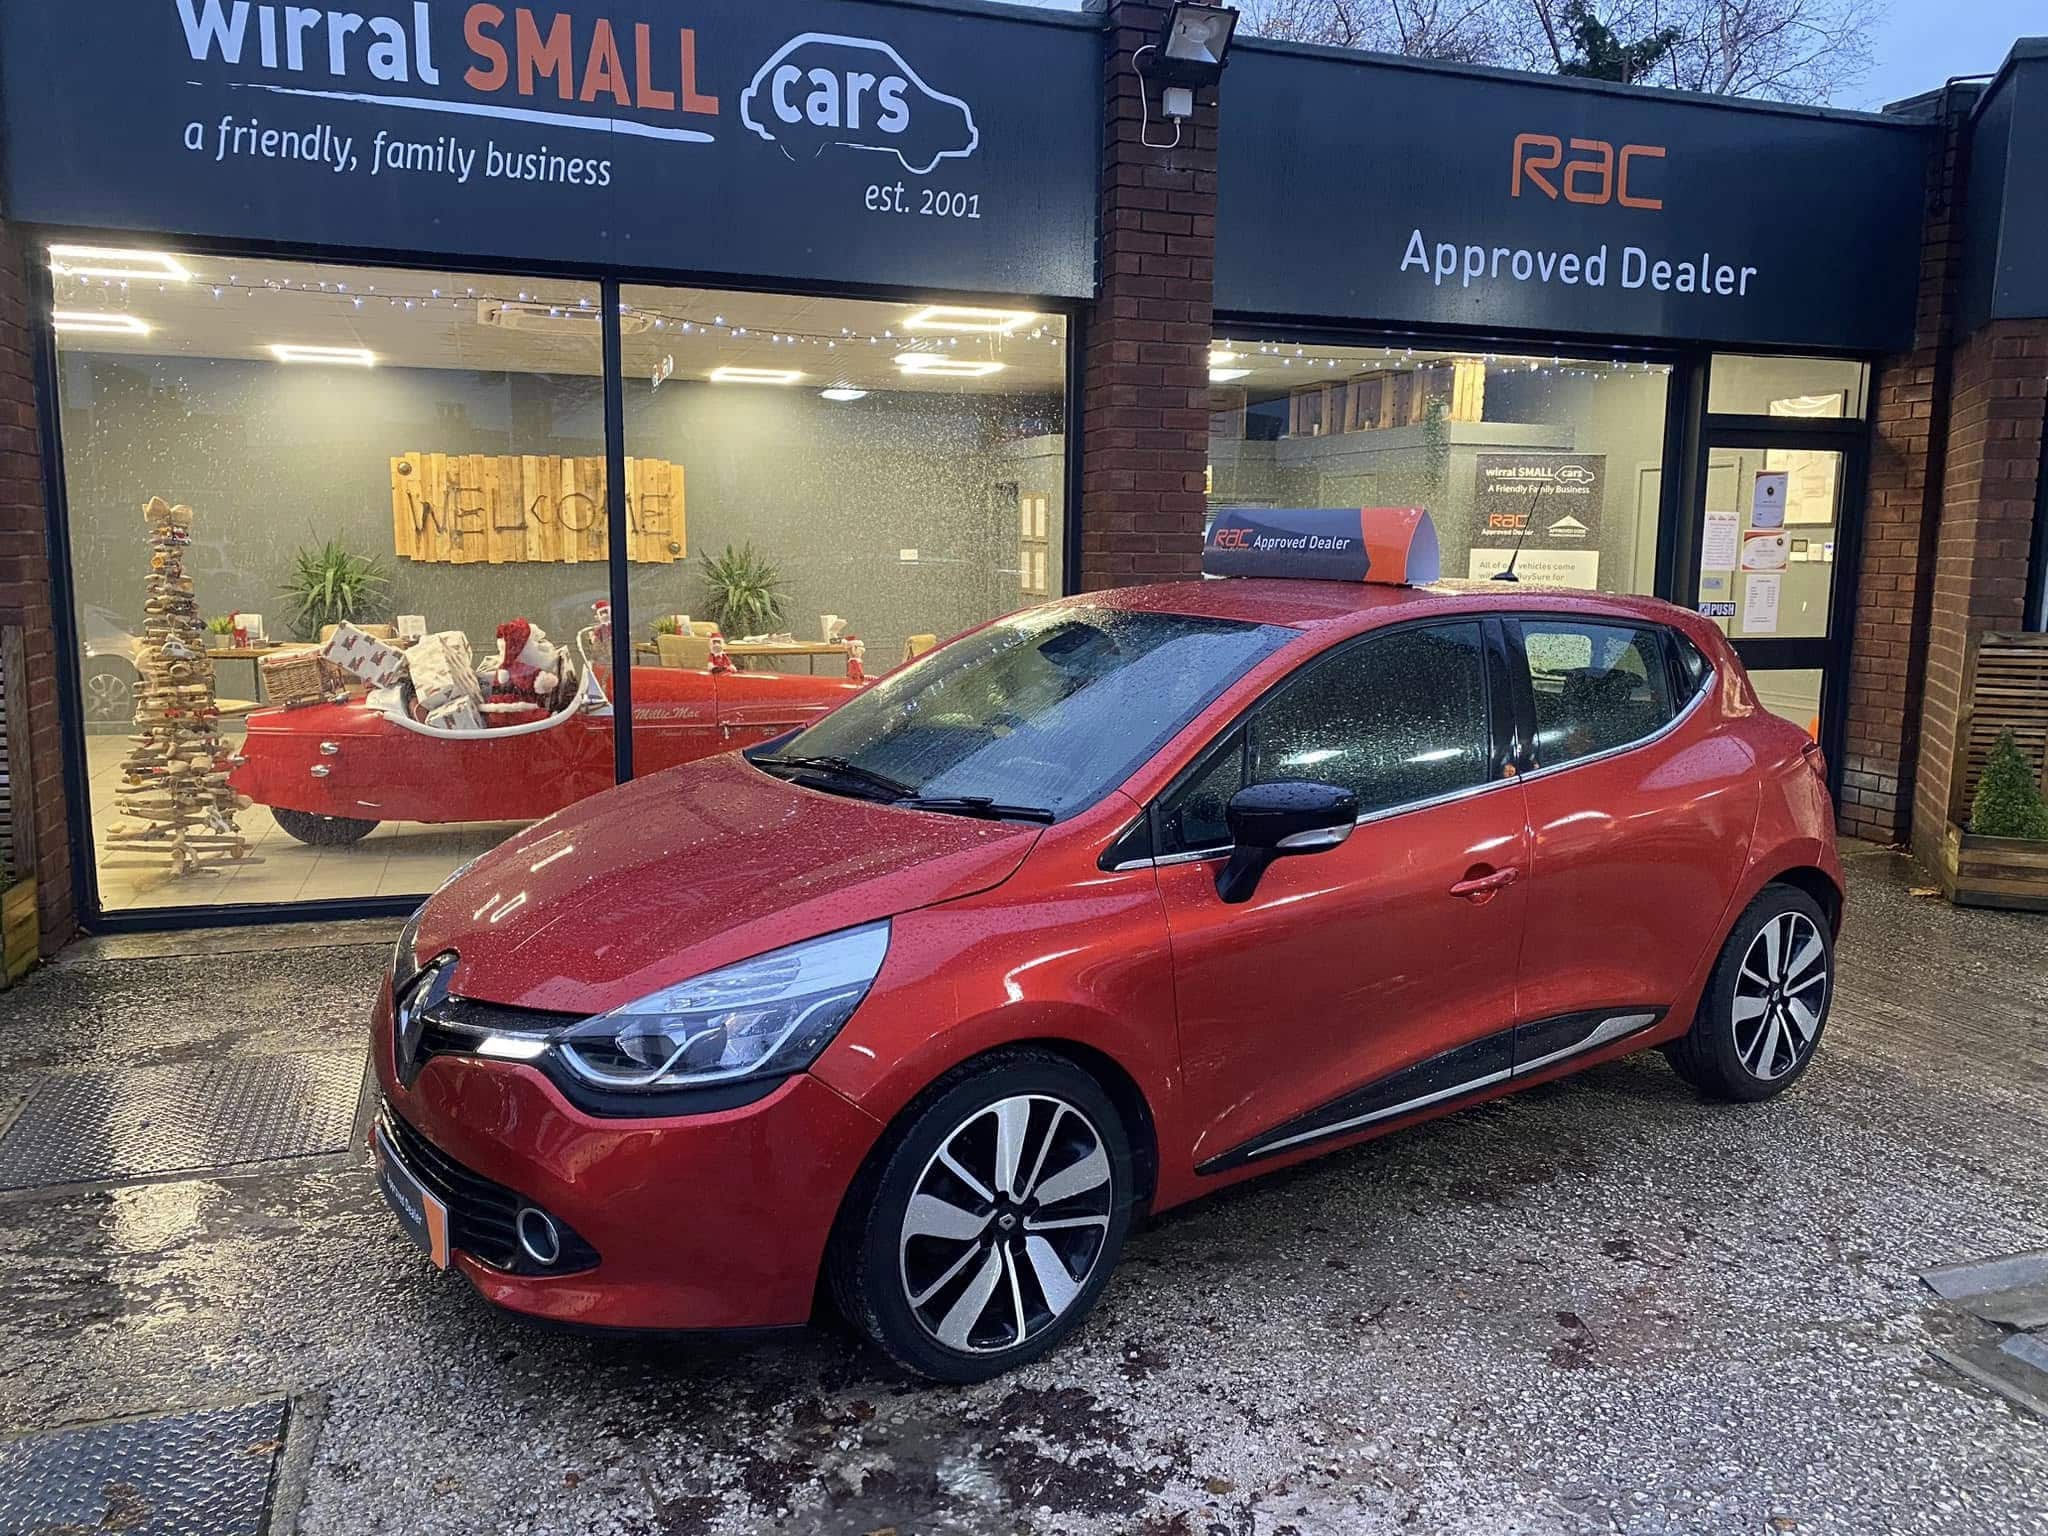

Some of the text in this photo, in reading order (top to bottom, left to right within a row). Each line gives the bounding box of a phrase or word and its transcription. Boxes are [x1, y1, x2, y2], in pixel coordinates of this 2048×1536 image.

[464, 3, 720, 115] SMALL
[772, 64, 910, 133] cars
[184, 116, 611, 186] a friendly, family business
[865, 181, 981, 218] est. 2001
[1400, 229, 1757, 296] Approved Dealer
[1518, 467, 1553, 478] SMALL
[1561, 469, 1583, 478] cars
[1253, 534, 1307, 551] Approved
[1309, 536, 1350, 549] Dealer
[1710, 603, 1735, 616] PUSH
